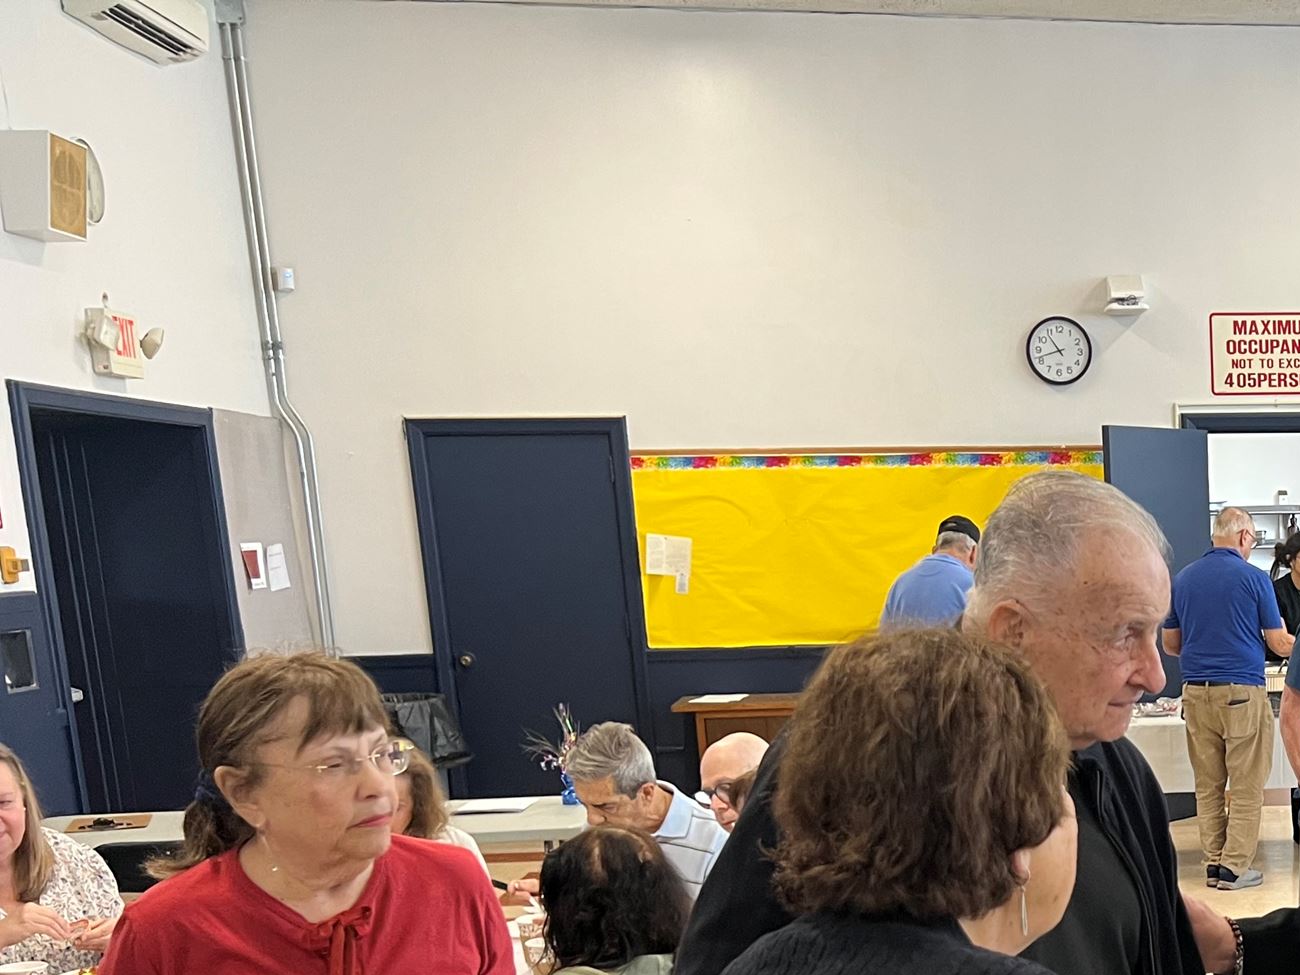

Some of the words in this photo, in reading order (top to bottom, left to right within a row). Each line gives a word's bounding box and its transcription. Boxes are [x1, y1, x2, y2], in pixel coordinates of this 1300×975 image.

[1046, 328, 1053, 337] 11
[1055, 325, 1064, 334] 12
[1067, 329, 1072, 337] 1
[1038, 336, 1047, 344] 10
[1074, 338, 1081, 346] 2
[1035, 345, 1042, 354] 9
[1077, 347, 1084, 357] 3
[1038, 356, 1045, 366] 8
[1074, 359, 1080, 367] 4
[1231, 358, 1254, 369] NOT
[1258, 358, 1274, 369] TO
[1046, 365, 1052, 373] 7
[1056, 368, 1063, 377] 6
[1066, 366, 1073, 375] 5
